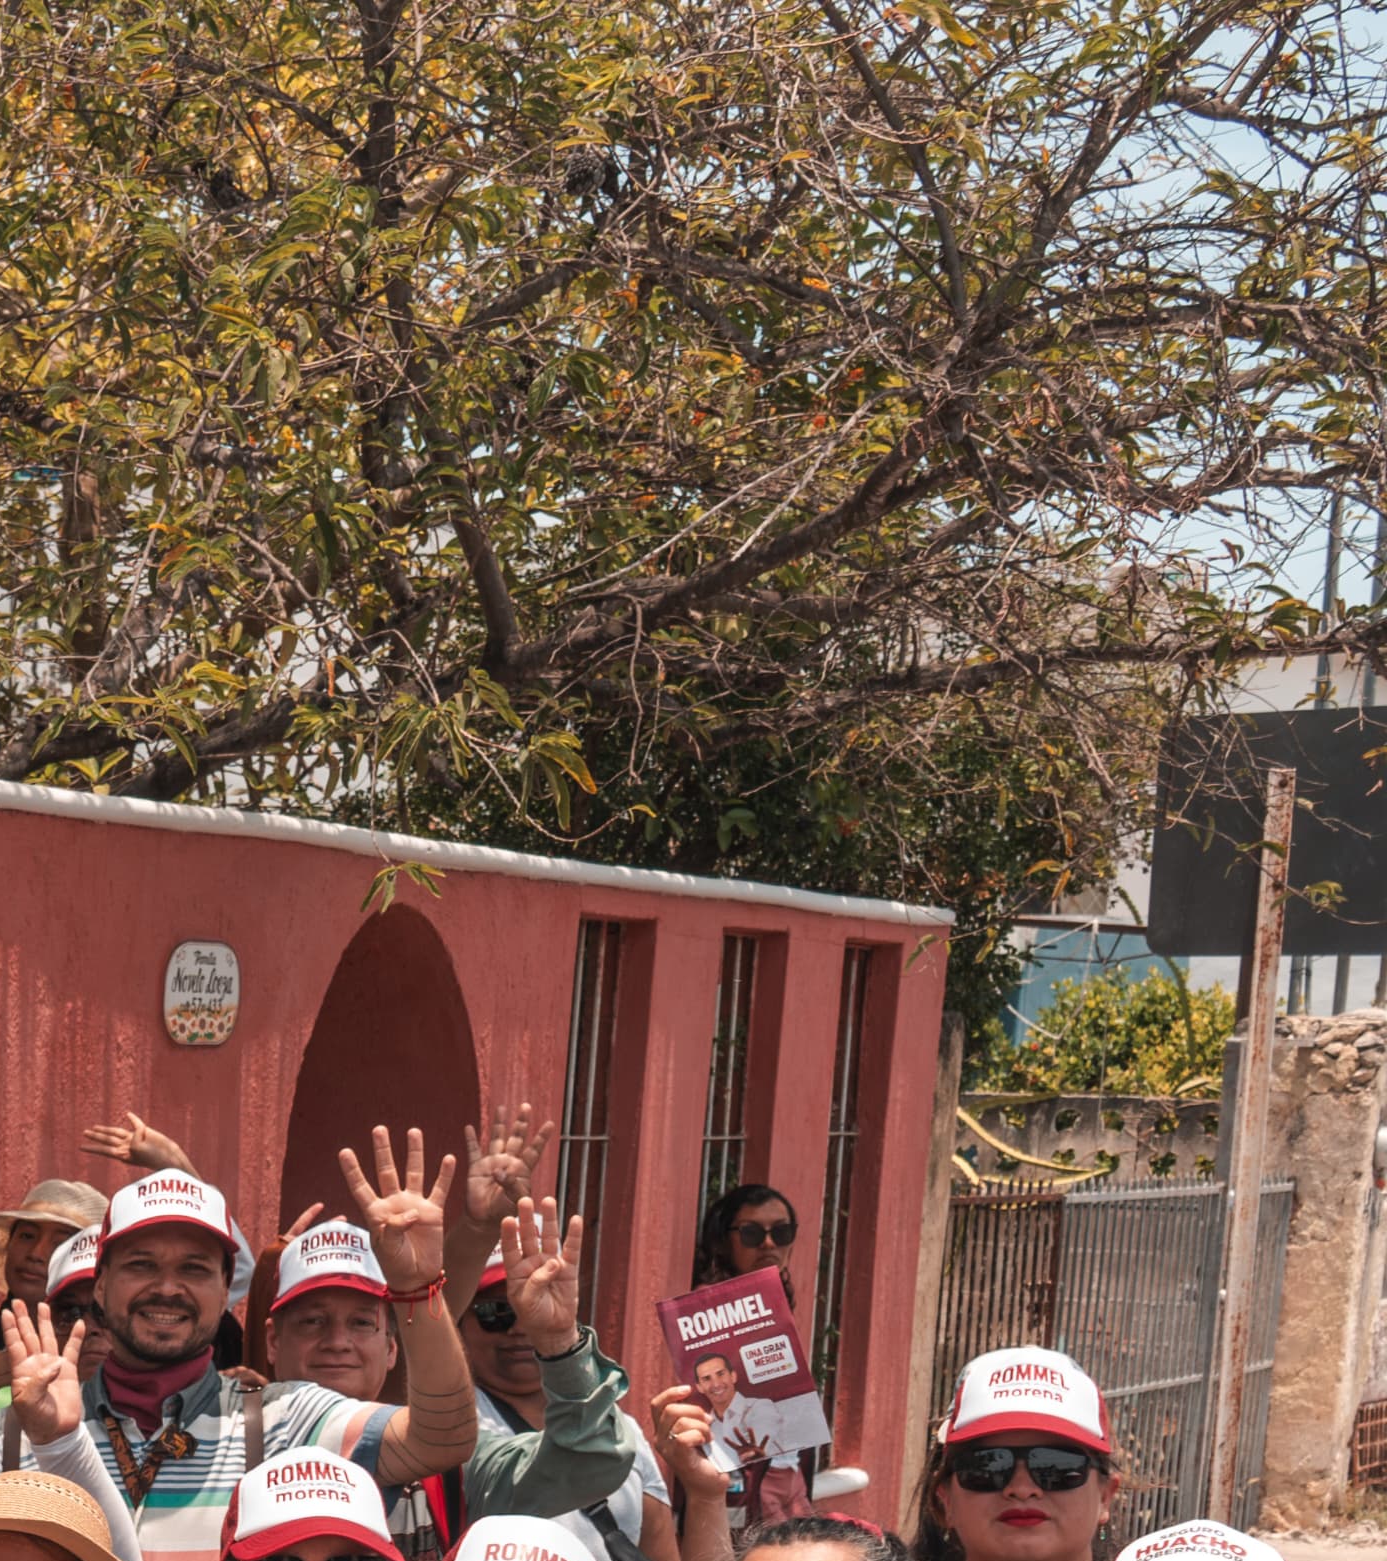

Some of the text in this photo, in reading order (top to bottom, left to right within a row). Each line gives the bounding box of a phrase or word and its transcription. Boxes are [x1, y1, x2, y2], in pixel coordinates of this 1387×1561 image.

[138, 1179, 206, 1203] ROMMEL
[301, 1231, 369, 1257] ROMMEL
[306, 1252, 362, 1267] morena
[677, 1293, 773, 1341] ROMMEL
[763, 1340, 786, 1354] GRAN
[988, 1363, 1070, 1391] ROMMEL
[993, 1387, 1064, 1403] morena
[266, 1460, 356, 1489] ROMMEL
[275, 1486, 351, 1505] morena
[1159, 1526, 1225, 1540] SEGURO
[1135, 1534, 1247, 1559] HUACHO
